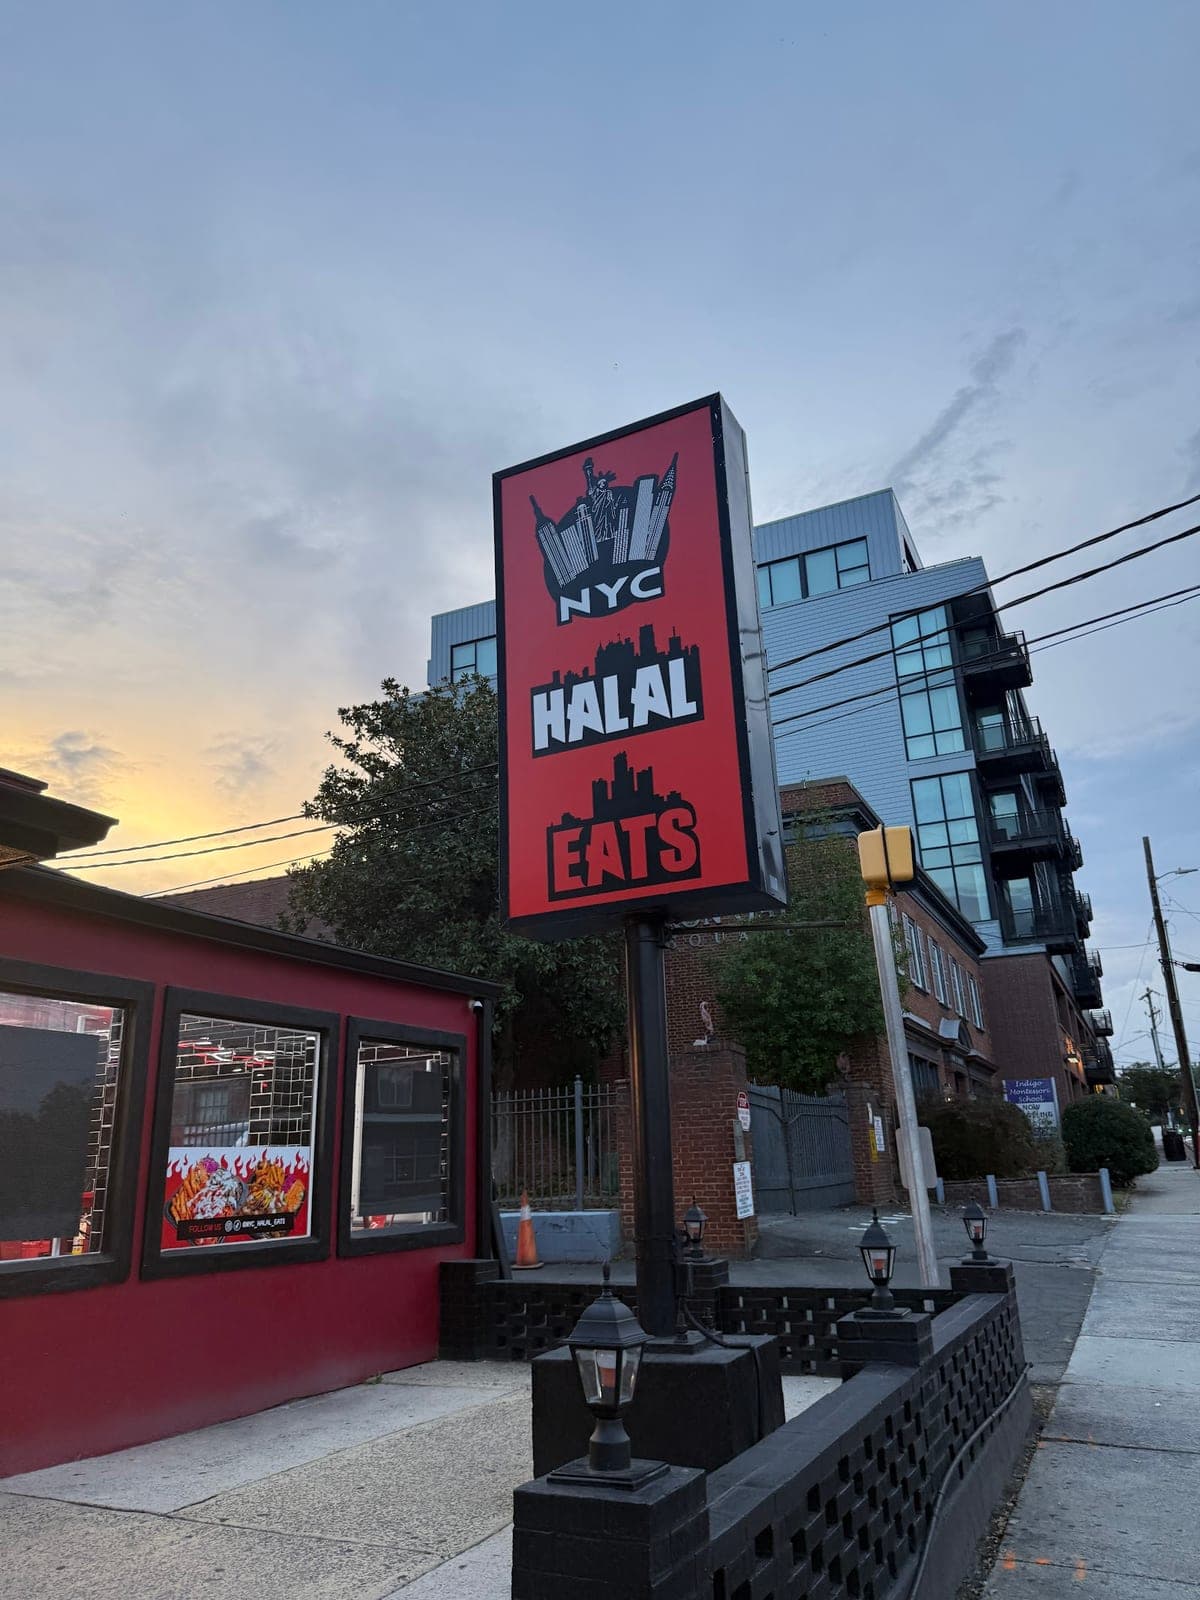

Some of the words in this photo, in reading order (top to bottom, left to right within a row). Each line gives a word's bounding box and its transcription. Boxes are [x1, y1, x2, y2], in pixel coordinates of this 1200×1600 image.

[560, 566, 662, 623] NYC
[532, 657, 698, 751] HALAL
[553, 807, 699, 894] EATS
[1015, 1080, 1042, 1088] Indigo
